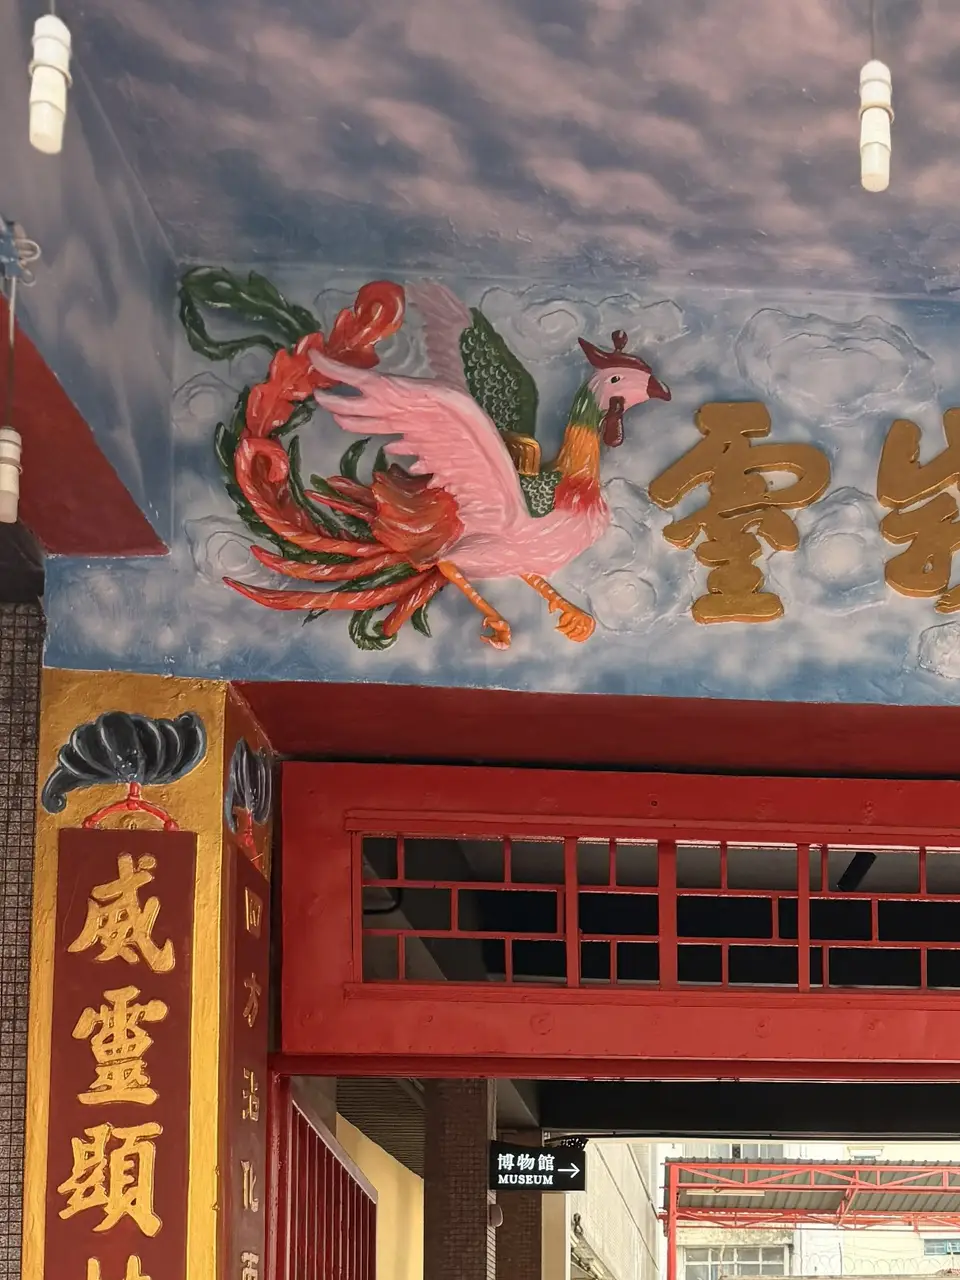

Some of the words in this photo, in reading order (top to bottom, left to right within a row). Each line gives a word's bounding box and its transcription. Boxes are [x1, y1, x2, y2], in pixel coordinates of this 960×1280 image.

[497, 1153, 555, 1171] 博物館
[497, 1174, 554, 1185] MUSEUM
